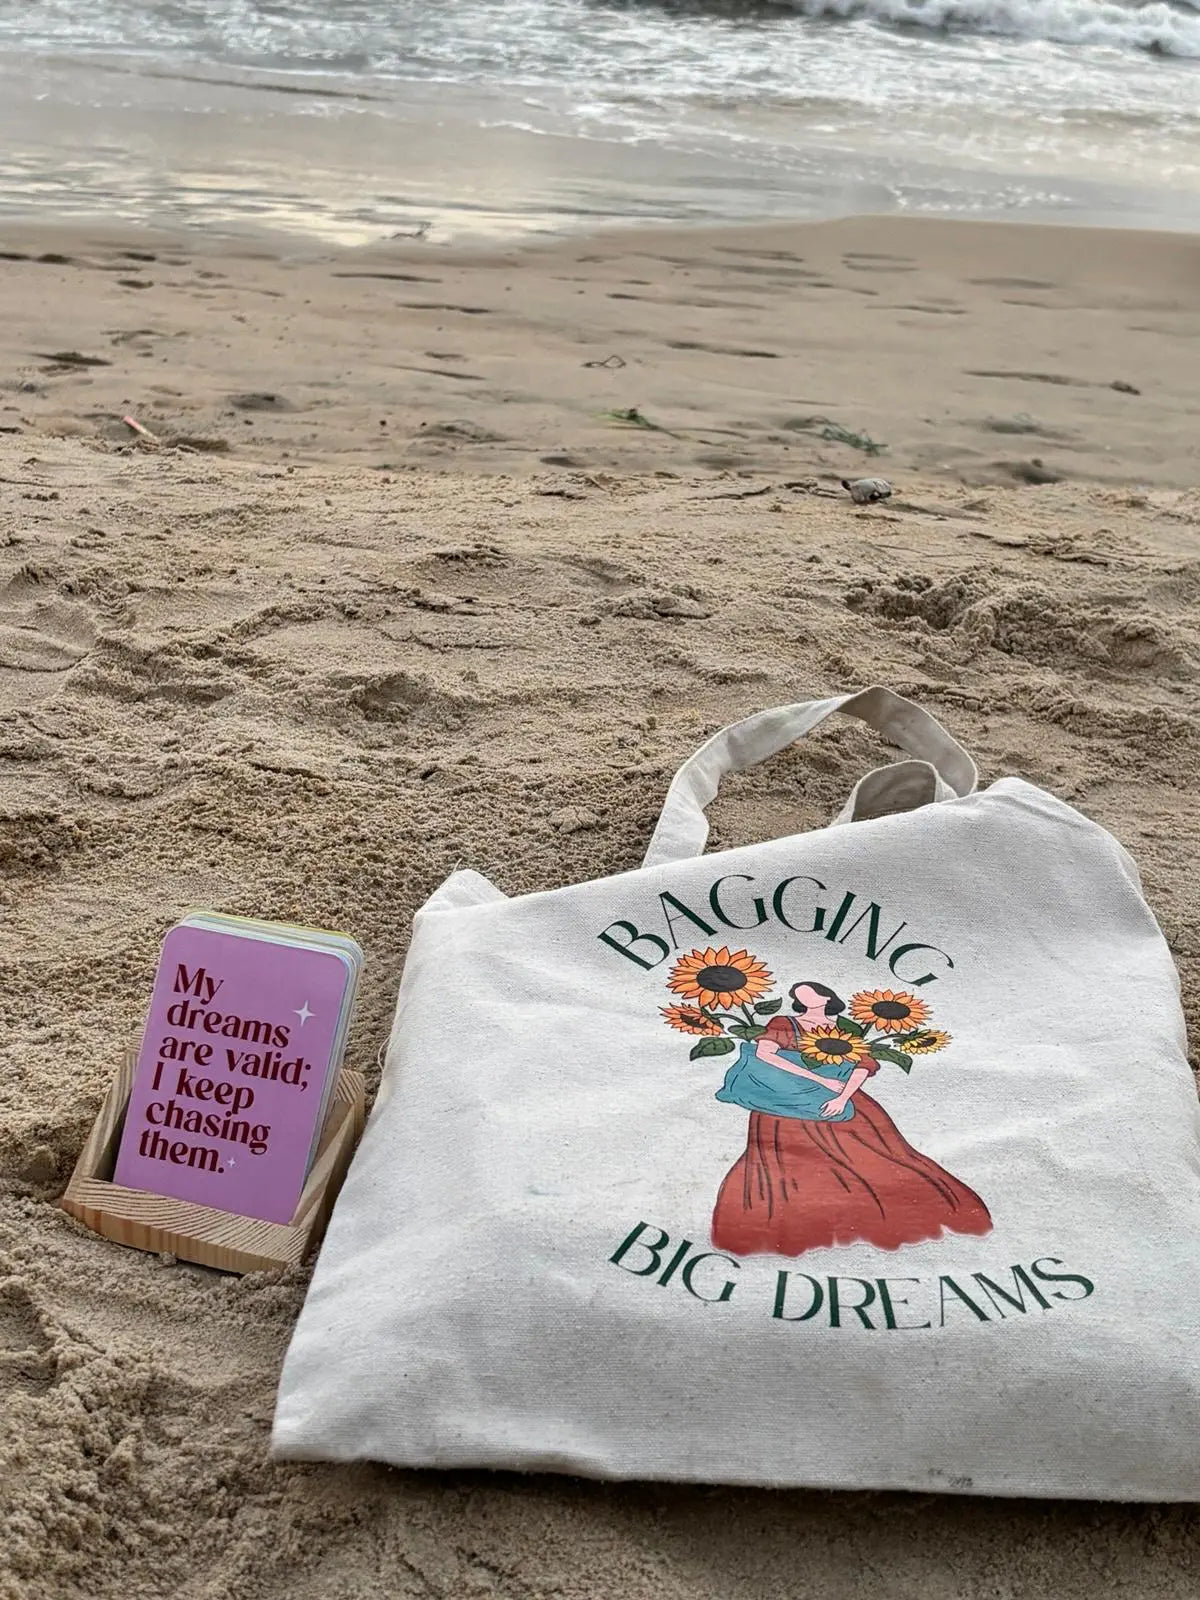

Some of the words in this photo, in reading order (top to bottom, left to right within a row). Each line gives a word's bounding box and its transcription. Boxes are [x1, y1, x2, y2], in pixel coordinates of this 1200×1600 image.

[597, 874, 954, 987] BAGGING
[173, 964, 223, 1005] My
[167, 1000, 290, 1048] dreams
[152, 1062, 165, 1091] I
[176, 1068, 255, 1114] keep
[159, 1036, 213, 1066] are
[226, 1049, 312, 1092] valid;
[139, 1128, 224, 1173] them.
[146, 1100, 271, 1155] chasing
[608, 1221, 740, 1302] BIG
[772, 1257, 1094, 1330] DREAMS
